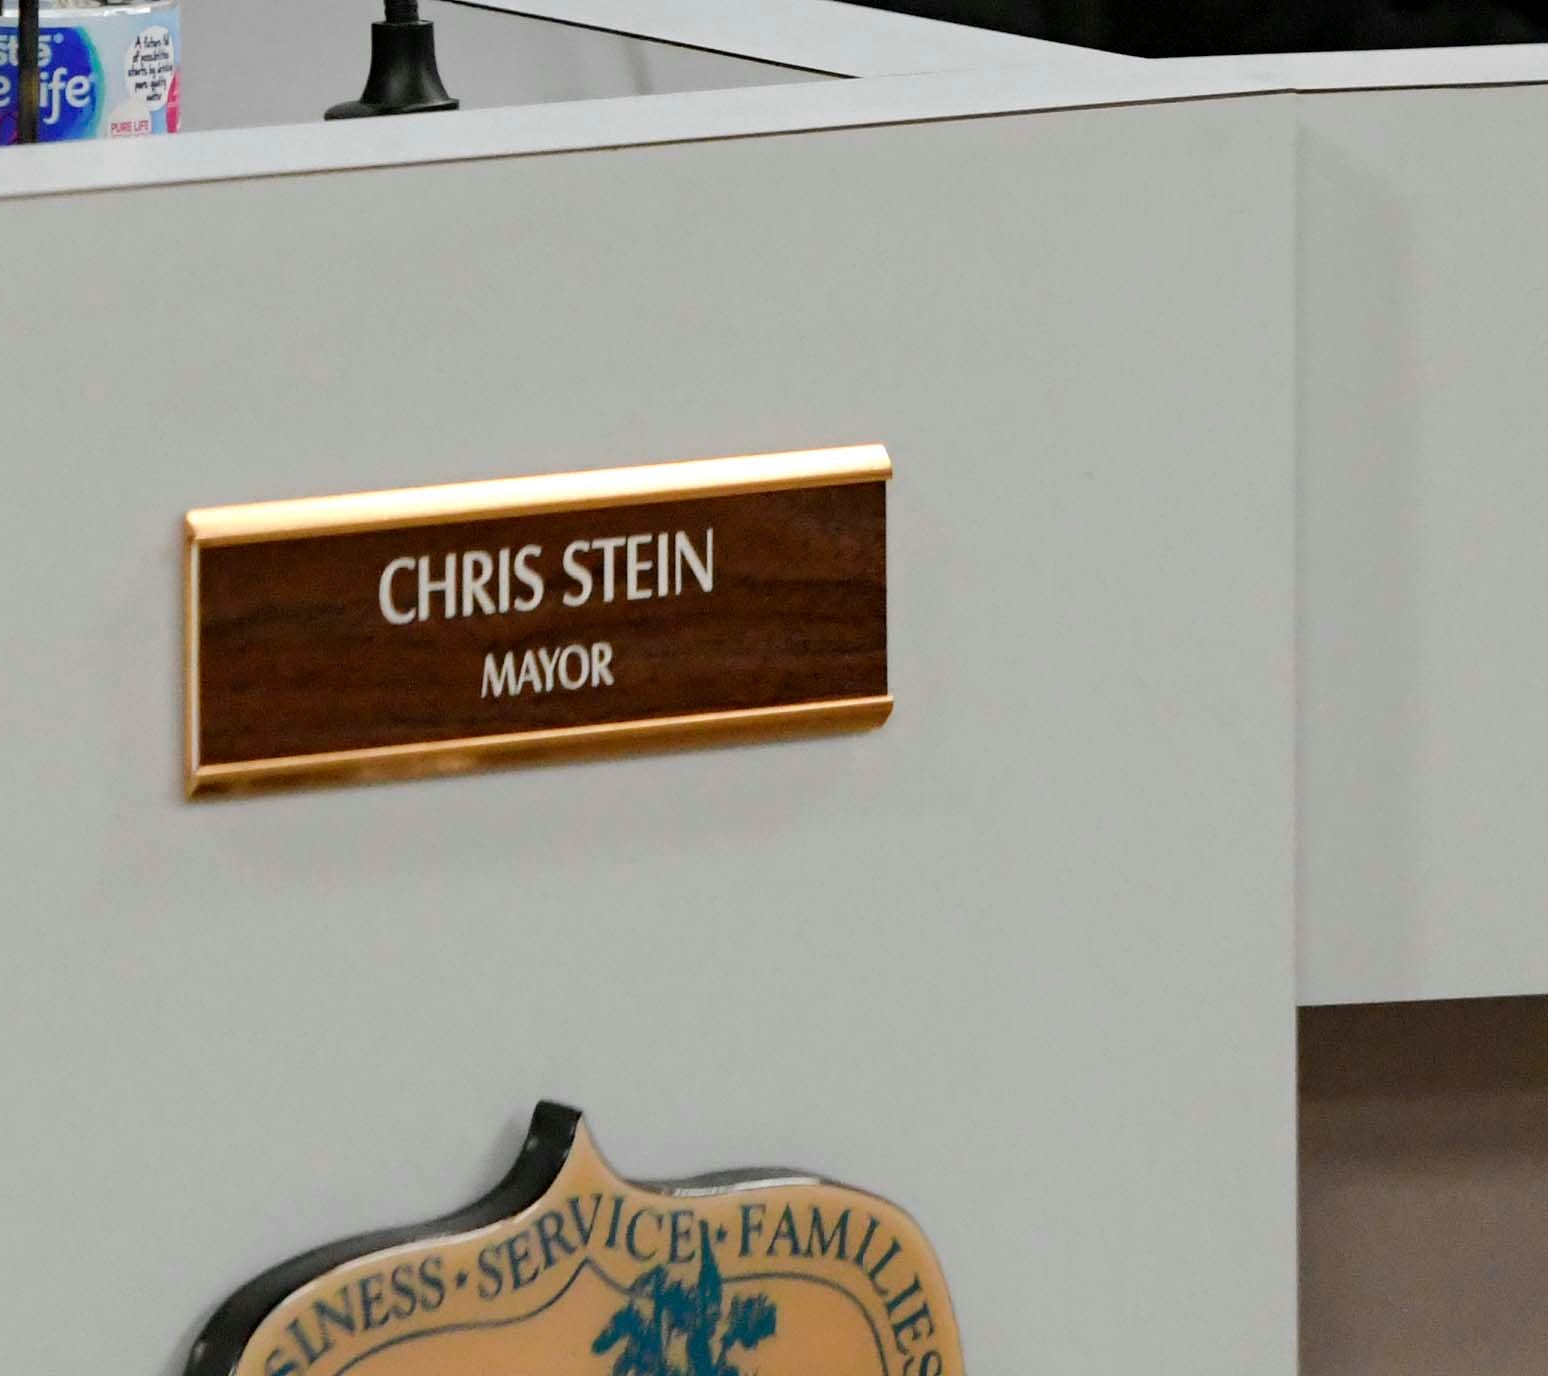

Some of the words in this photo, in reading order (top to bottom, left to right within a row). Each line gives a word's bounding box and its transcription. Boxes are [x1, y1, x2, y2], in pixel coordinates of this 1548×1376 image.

[38, 67, 92, 125] ife
[379, 545, 544, 625] CHRIS
[562, 528, 715, 608] STEIN
[481, 641, 615, 699] MAYOR
[477, 1194, 697, 1300] SERVICE
